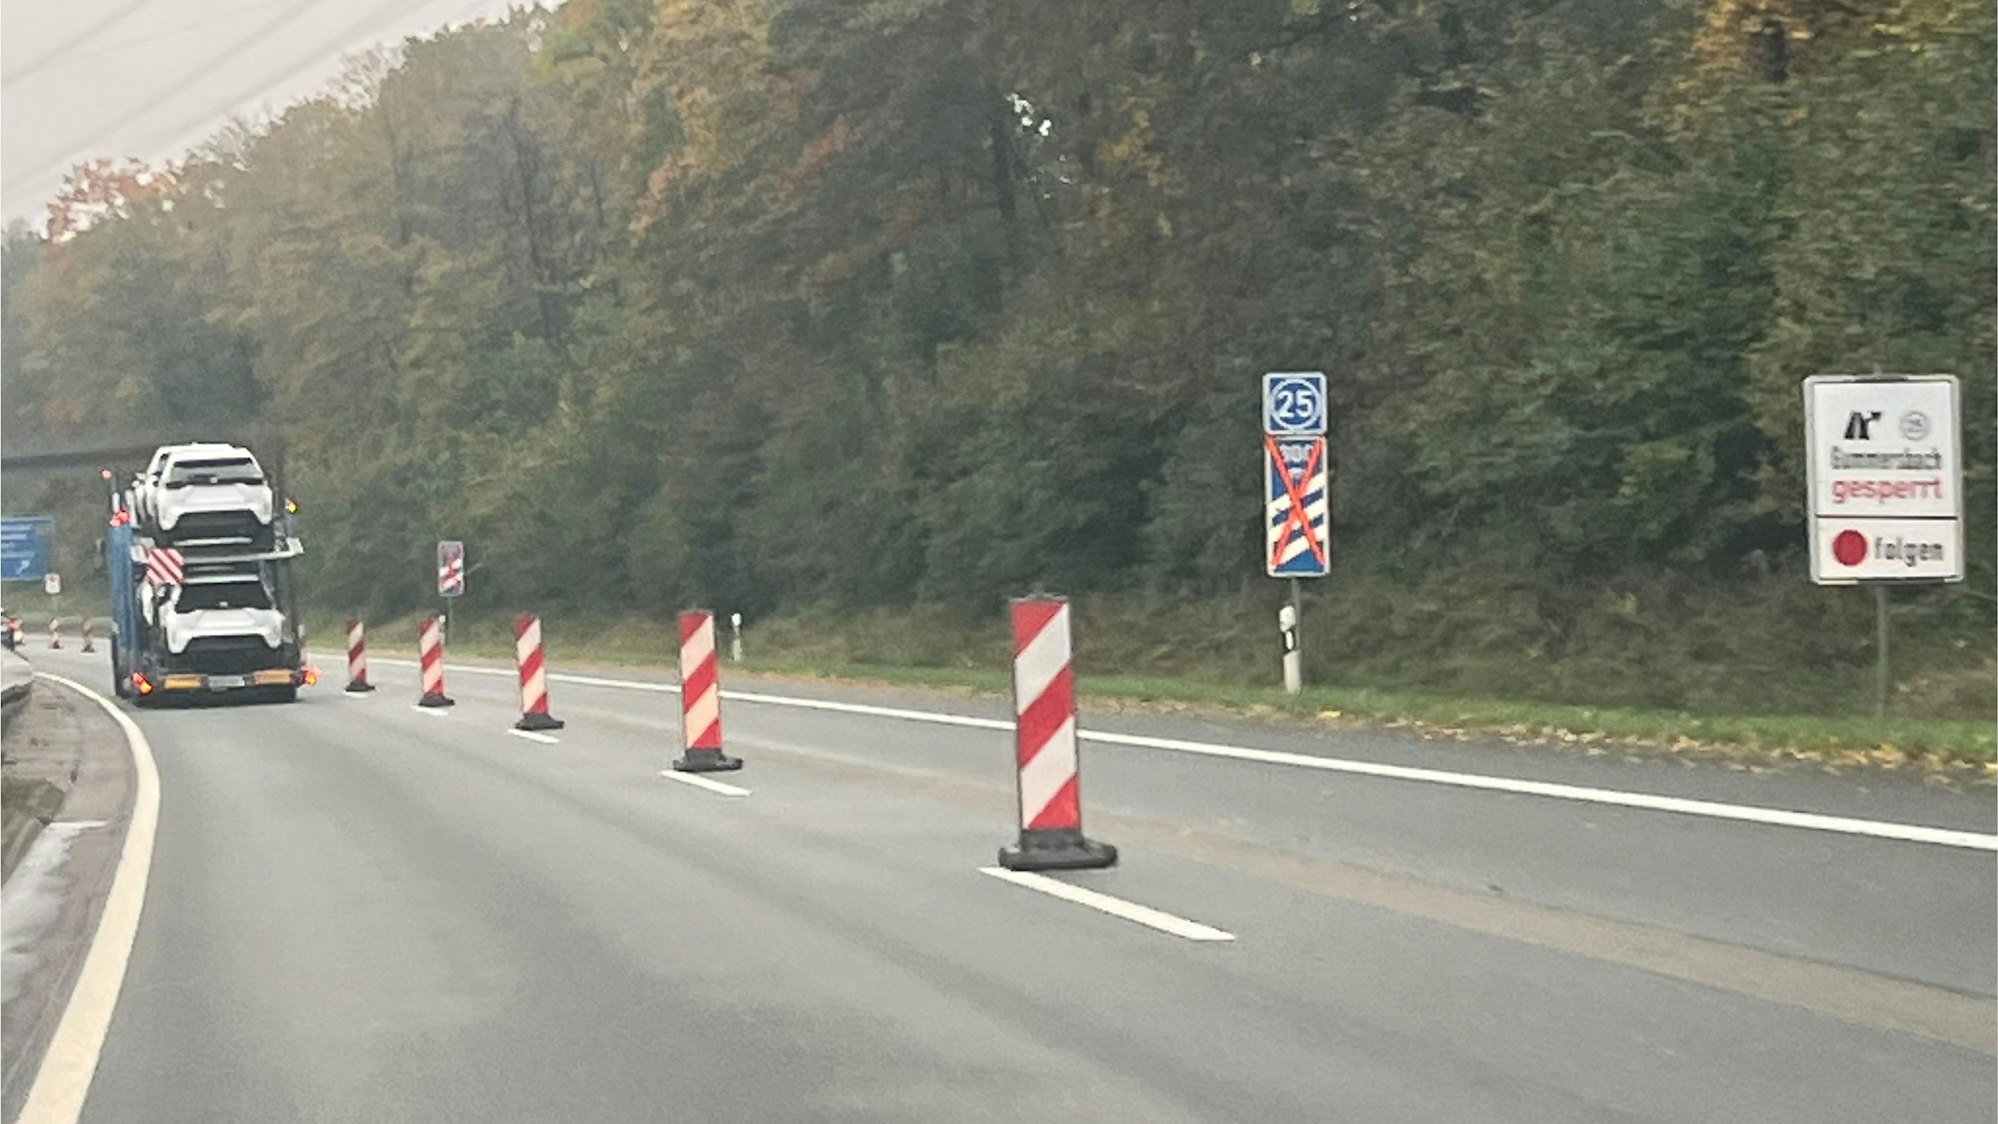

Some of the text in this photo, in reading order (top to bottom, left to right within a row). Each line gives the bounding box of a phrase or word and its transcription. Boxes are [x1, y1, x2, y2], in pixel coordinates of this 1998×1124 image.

[1278, 390, 1314, 418] 25
[1832, 478, 1943, 504] gesperrt
[1875, 537, 1944, 567] folgen
